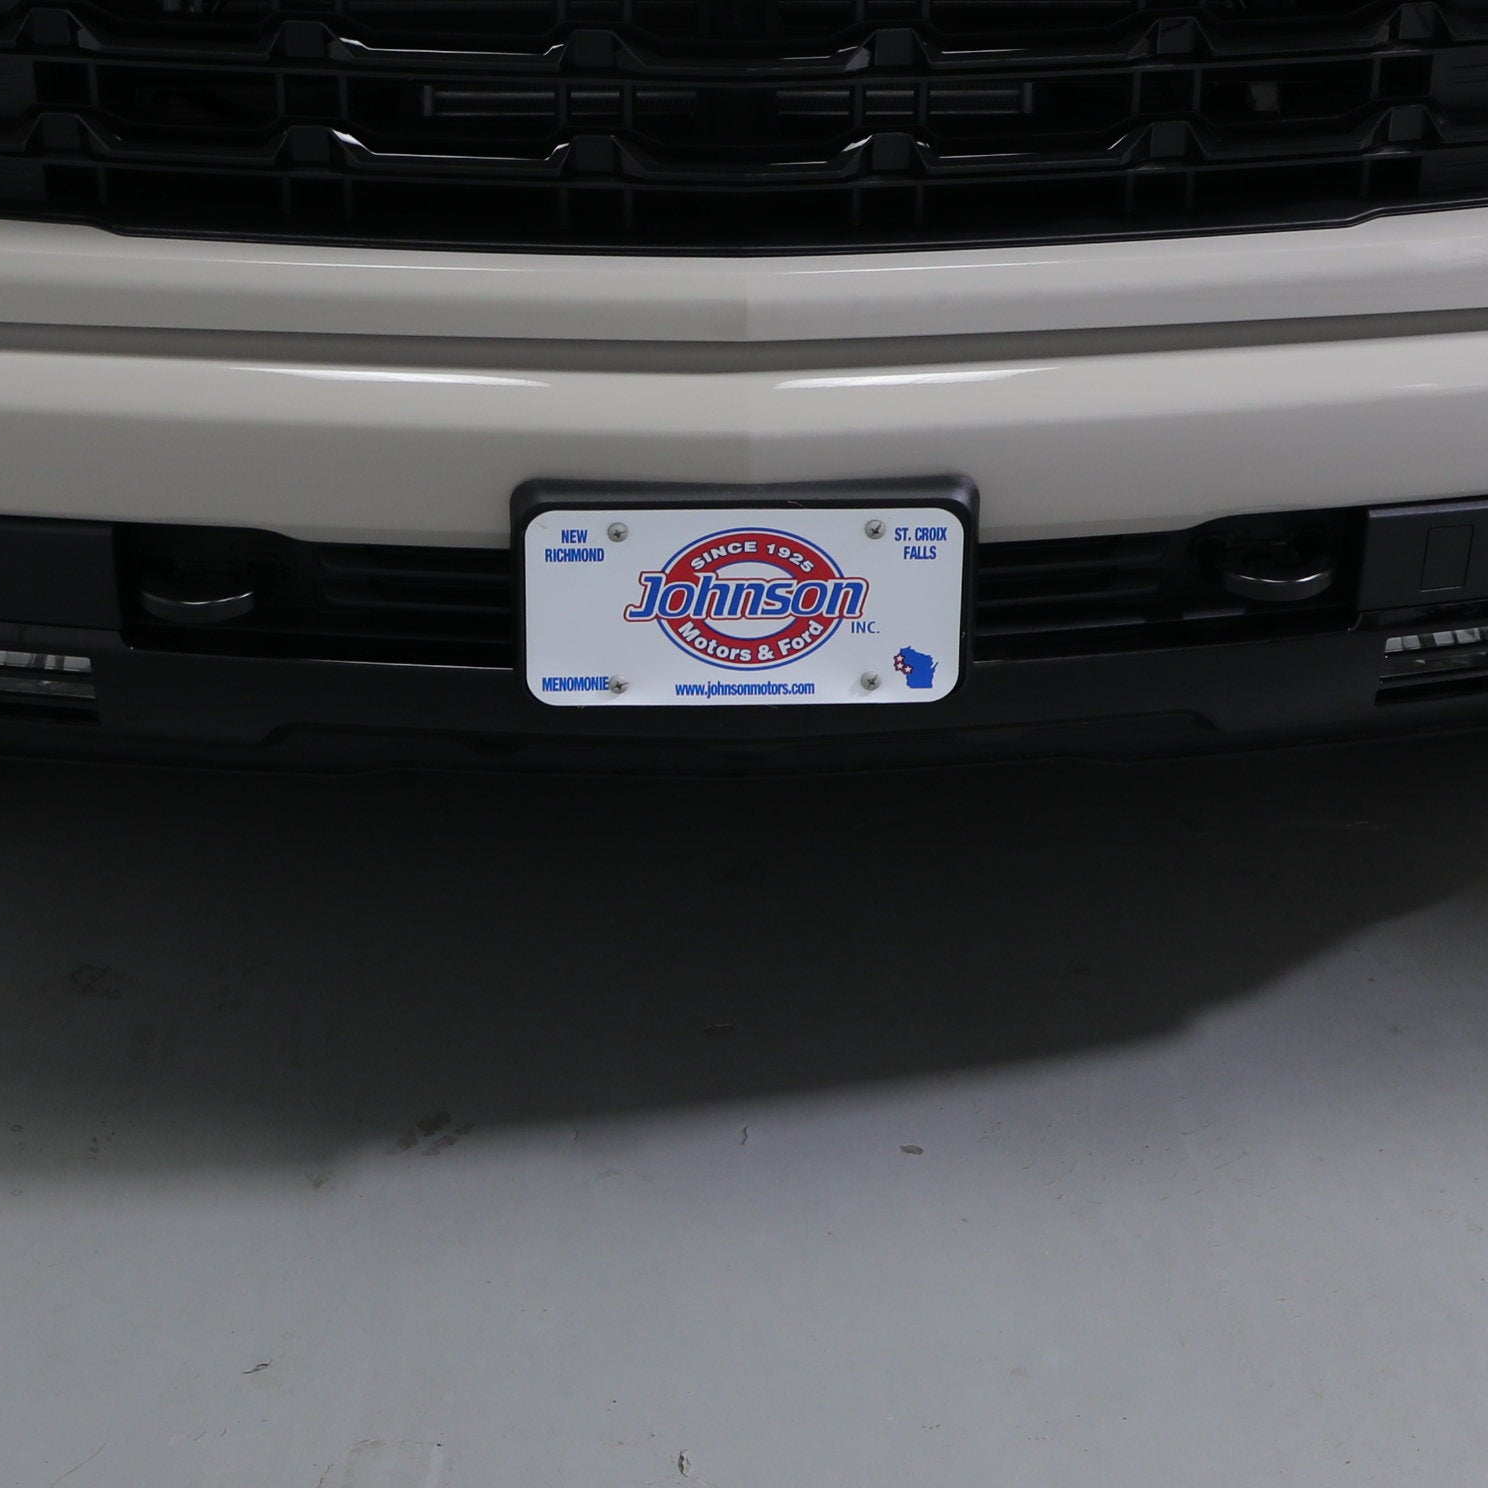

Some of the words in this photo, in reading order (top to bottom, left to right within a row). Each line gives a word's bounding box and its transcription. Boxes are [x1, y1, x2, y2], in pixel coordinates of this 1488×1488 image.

[561, 529, 588, 543] NEW
[894, 527, 912, 541] ST.
[915, 527, 948, 541] CROIX
[545, 548, 605, 562] RICHMOND
[691, 541, 758, 571] SINCE
[766, 543, 815, 573] 1925
[903, 545, 937, 560] FALLS
[626, 572, 867, 619] Johnson
[850, 621, 881, 634] INC.
[677, 620, 752, 661] Motors
[757, 644, 775, 661] &
[778, 619, 824, 656] Ford
[542, 676, 609, 692] MENOMONIE
[674, 681, 815, 699] www.johnsonmotors.com
